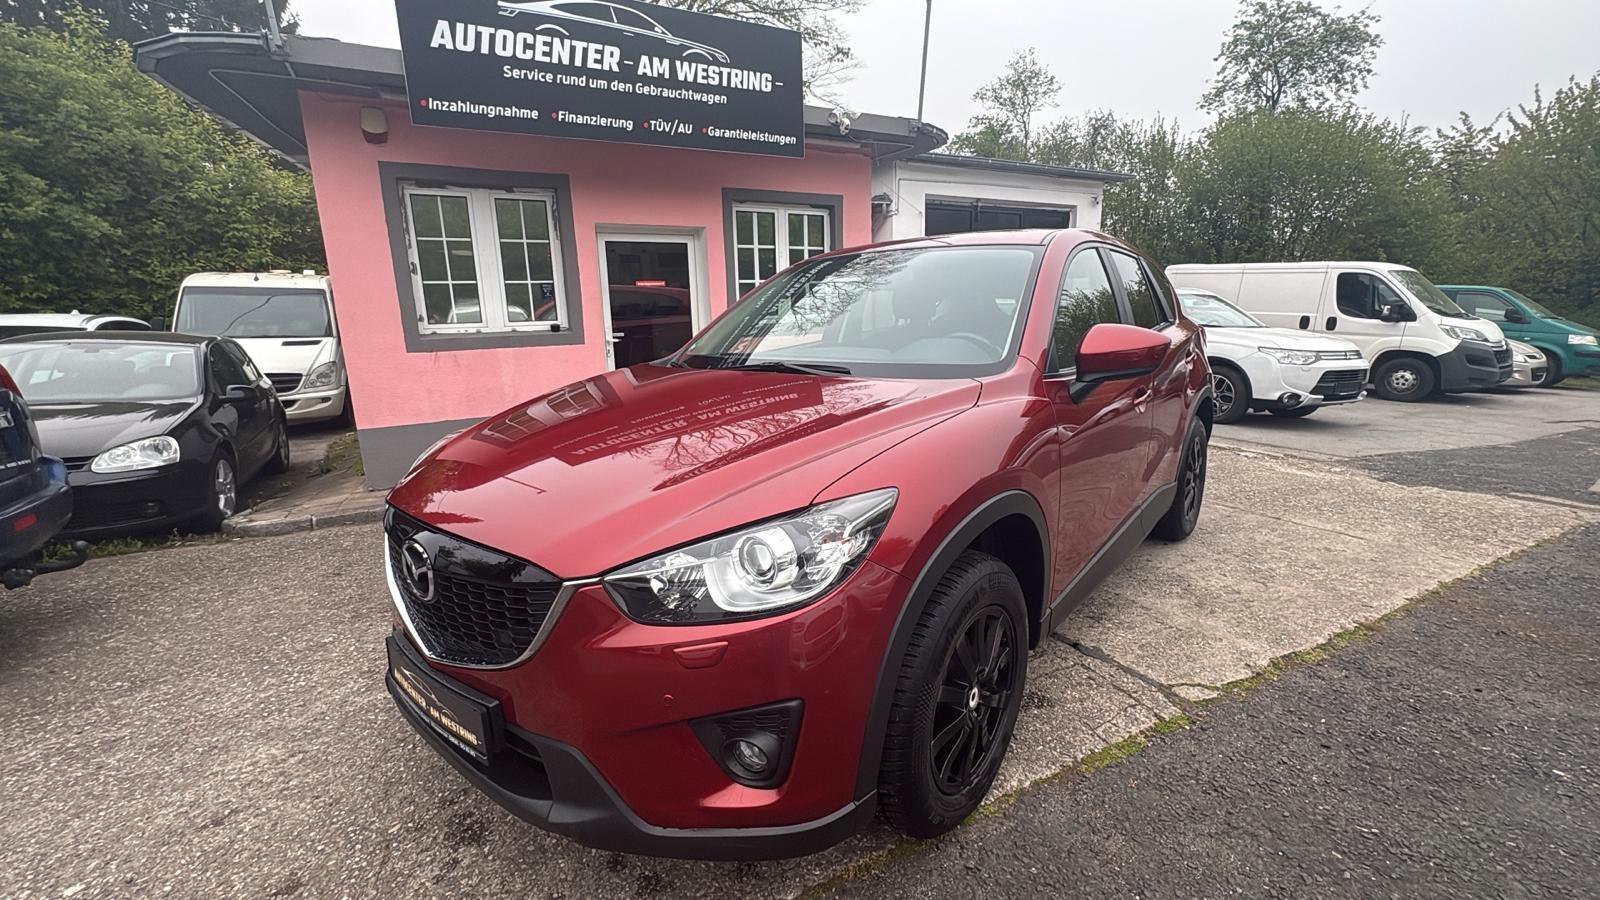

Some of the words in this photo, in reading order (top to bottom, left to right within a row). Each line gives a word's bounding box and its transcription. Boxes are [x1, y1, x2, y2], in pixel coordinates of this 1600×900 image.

[430, 19, 621, 72] AUTOCENTER
[637, 55, 670, 79] AM
[675, 60, 773, 93] WESTRING
[503, 65, 553, 83] Service
[557, 73, 586, 87] rund
[589, 78, 608, 91] um
[611, 80, 633, 93] den
[635, 83, 727, 104] Gebrauchtwagen
[428, 98, 539, 120] Inzahlungnahme
[558, 111, 634, 131] Finanzierung
[650, 118, 693, 135] TÜV/AU
[707, 126, 797, 145] Garantieleistungen
